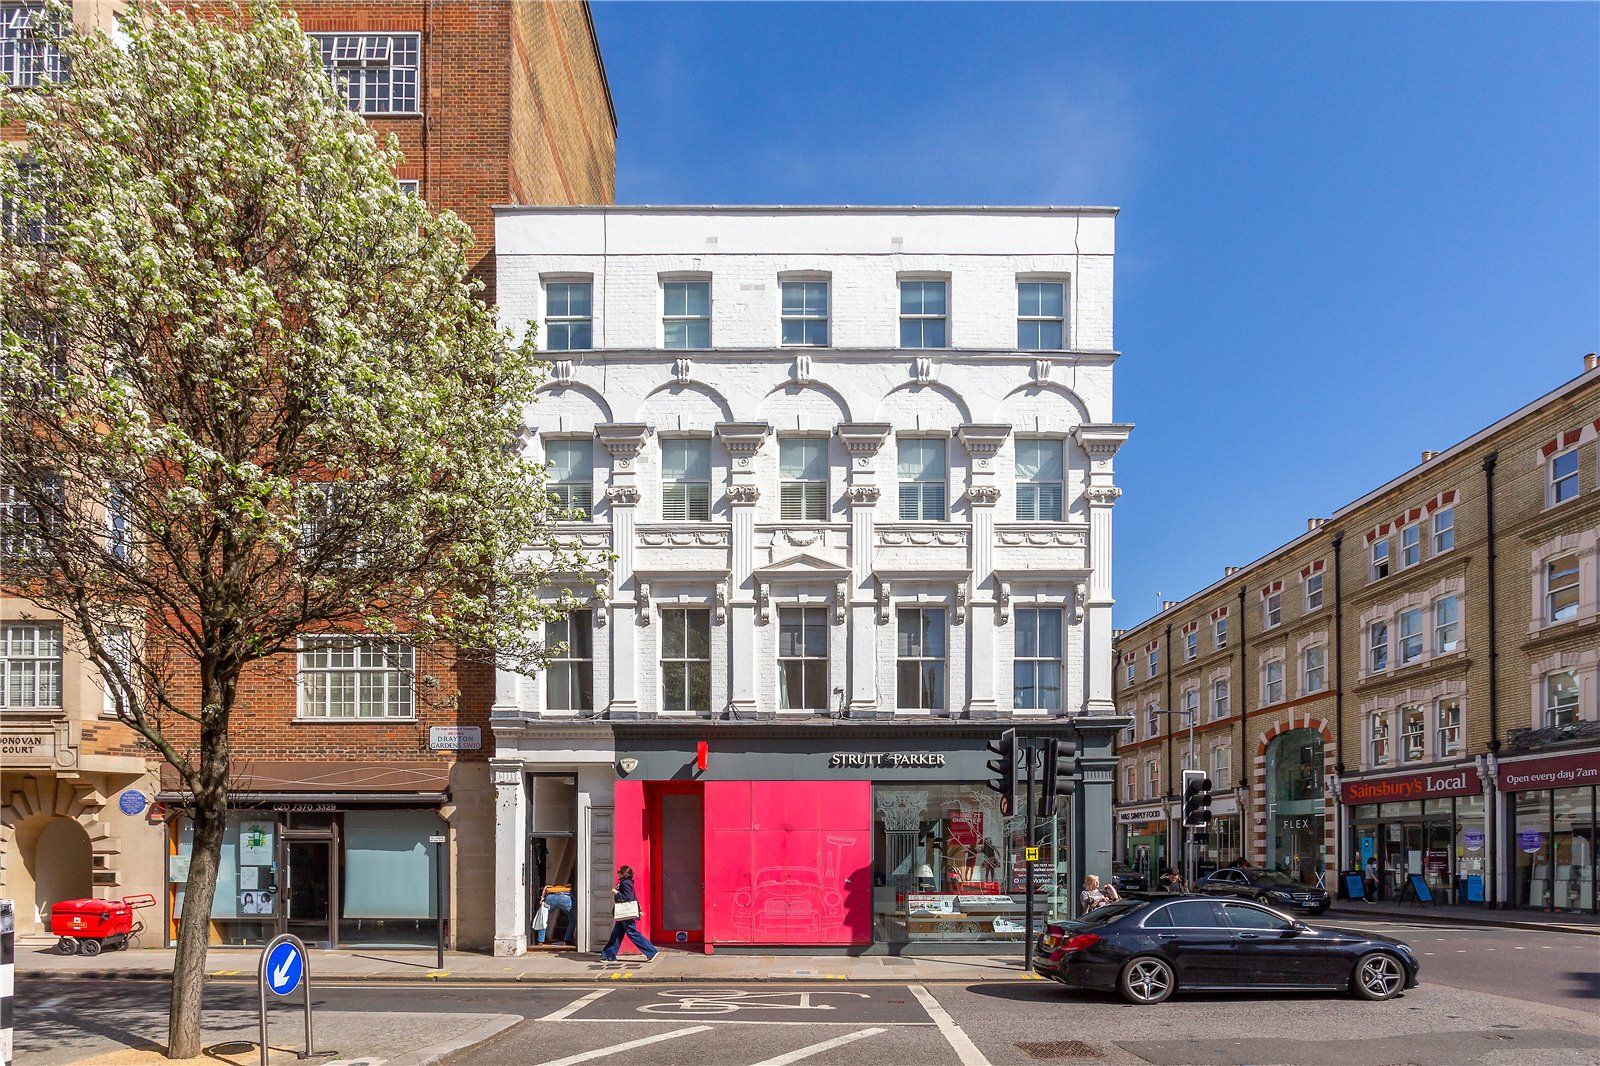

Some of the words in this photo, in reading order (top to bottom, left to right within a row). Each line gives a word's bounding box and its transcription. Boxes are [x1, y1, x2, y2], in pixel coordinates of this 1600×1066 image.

[0, 737, 42, 745] ONOVAN
[832, 753, 884, 765] STRUTT
[893, 753, 946, 765] PARKER
[1506, 774, 1529, 785] Open
[1530, 772, 1556, 782] every
[1557, 770, 1575, 780] day
[1576, 767, 1598, 777] 7am
[1349, 779, 1422, 799] Sainsbury's
[1426, 772, 1467, 792] Local
[272, 803, 290, 811] 020
[315, 803, 337, 811] 3329
[1146, 810, 1161, 818] FOOD
[1283, 819, 1309, 829] FLEX
